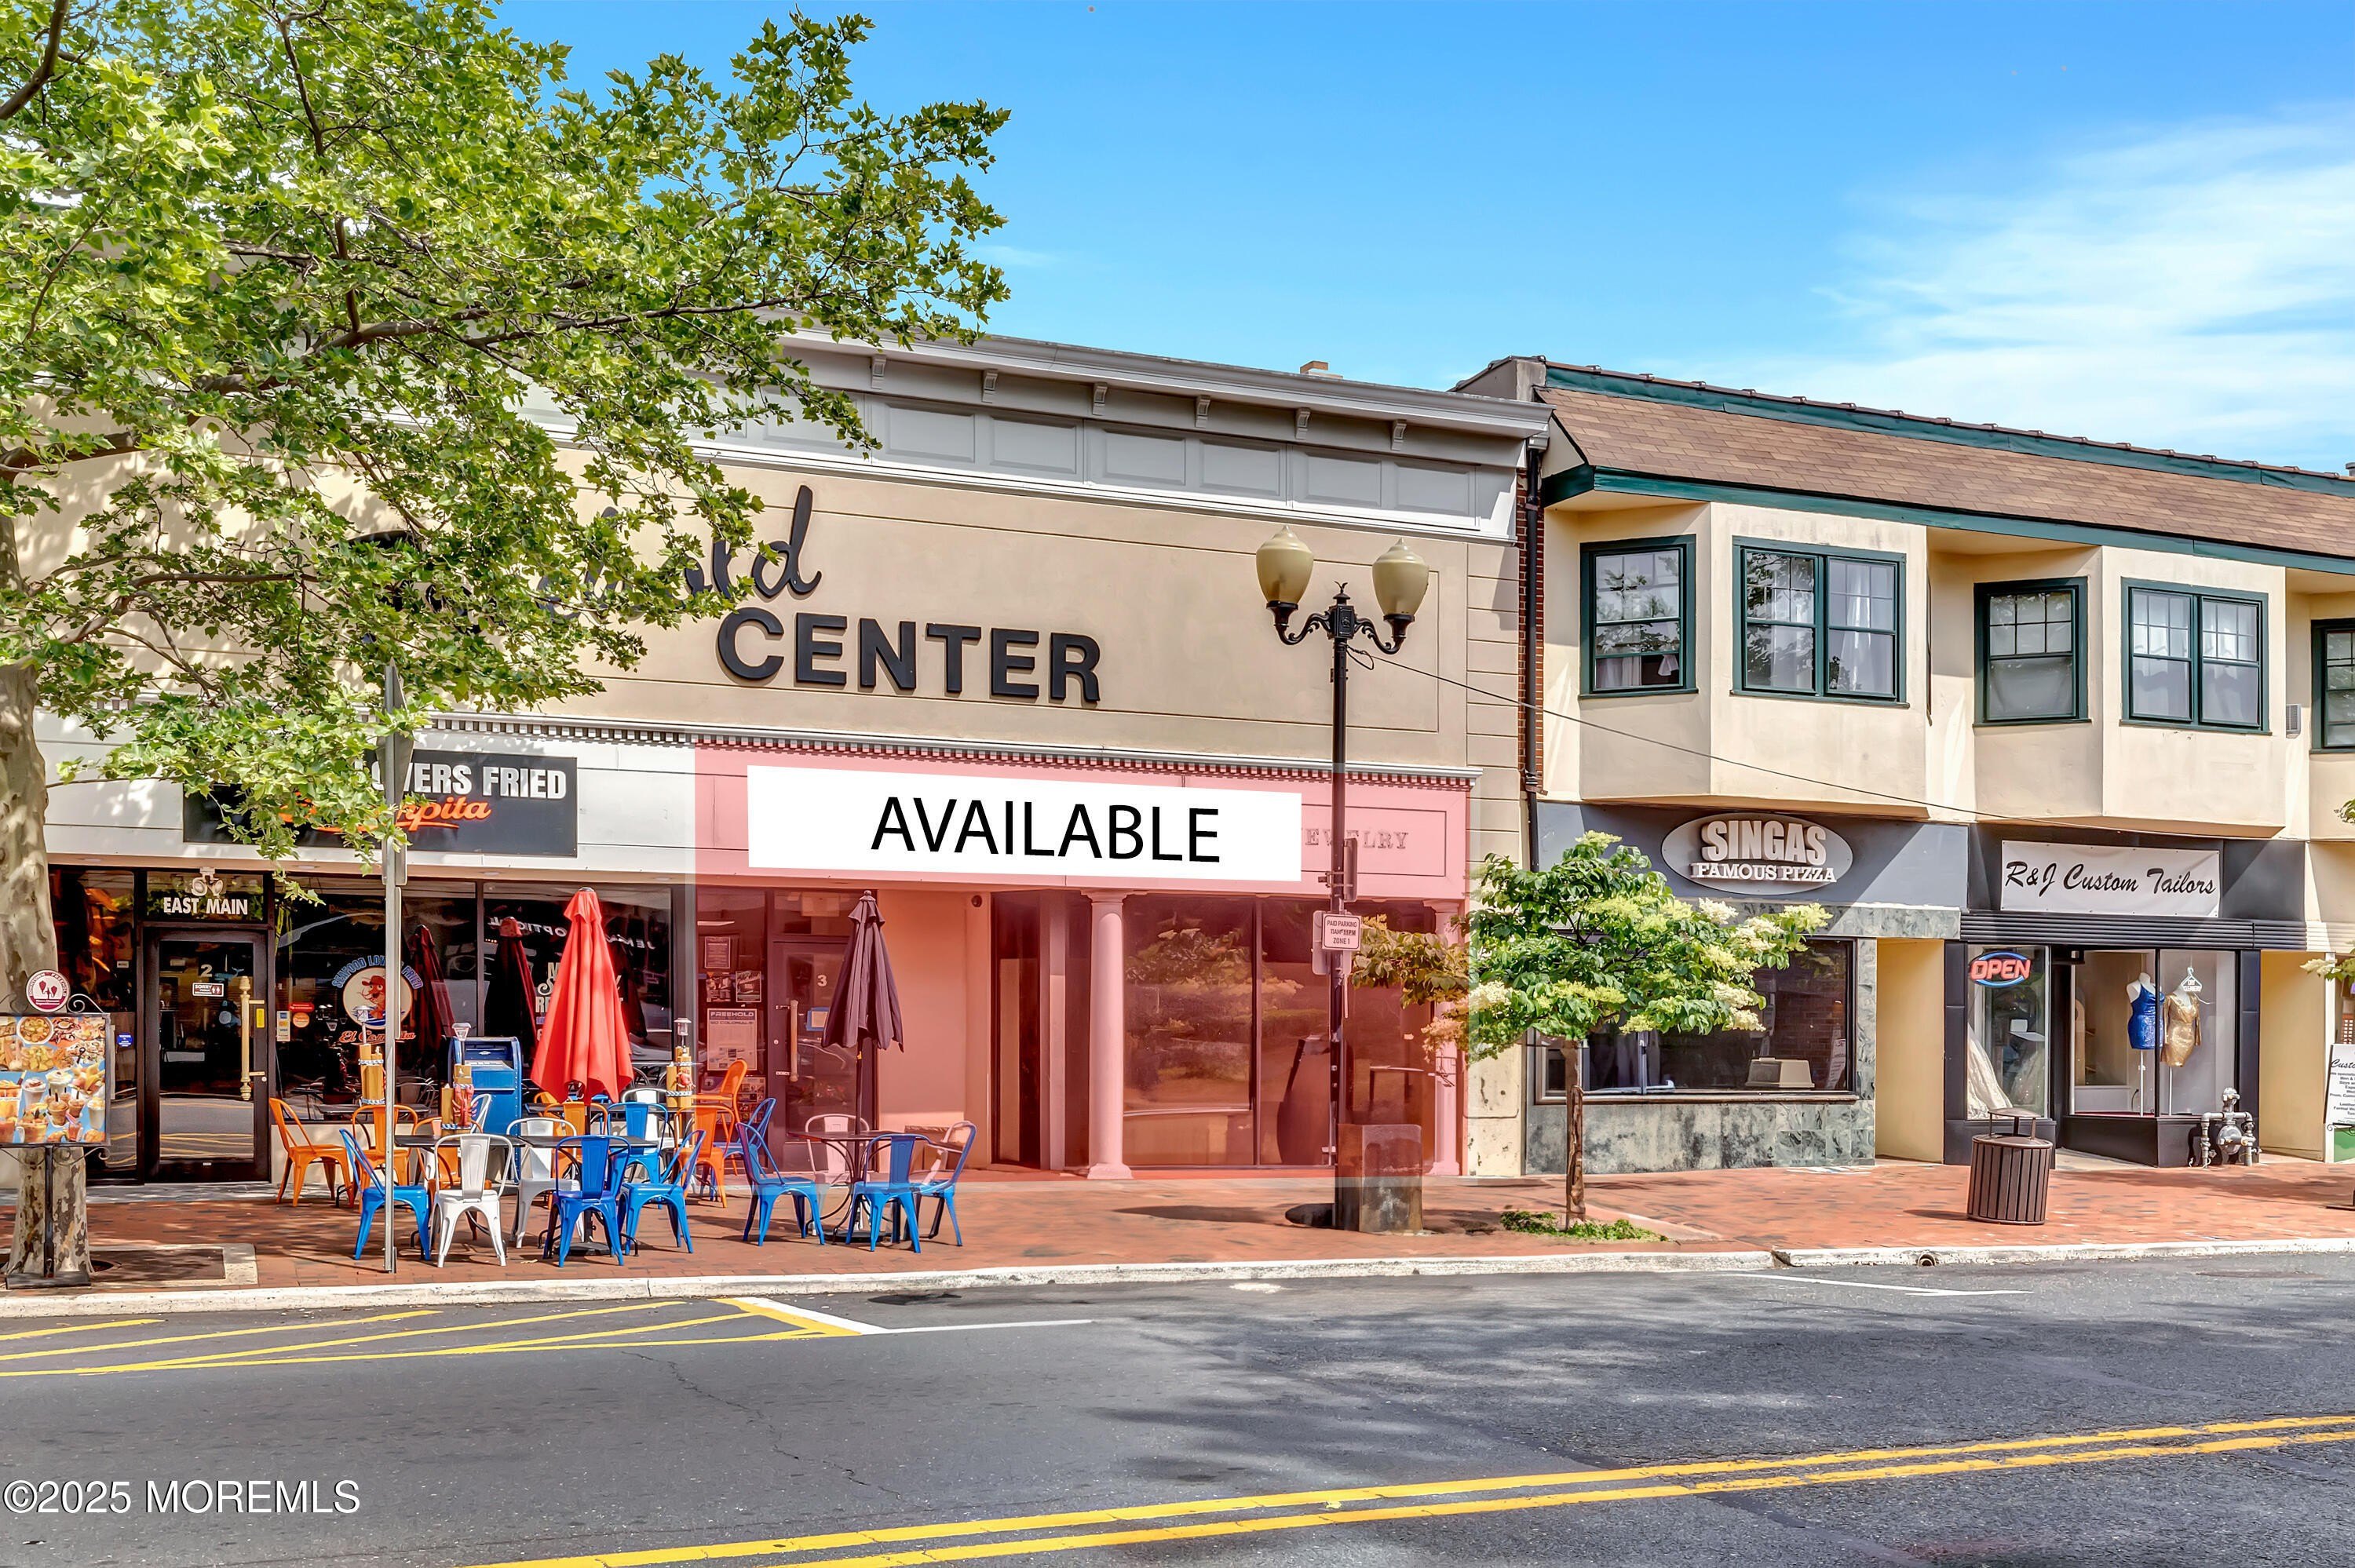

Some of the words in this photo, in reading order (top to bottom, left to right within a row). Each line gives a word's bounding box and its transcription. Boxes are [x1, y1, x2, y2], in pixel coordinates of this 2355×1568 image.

[717, 607, 1101, 702] CENTER
[356, 759, 472, 795] ERS
[484, 767, 567, 800] FRIED
[1302, 828, 1408, 849] ELRY
[1702, 820, 1827, 866] SINGAS
[1694, 862, 1778, 881] FAMOUS
[1780, 866, 1838, 883] PIZZA
[2005, 861, 2057, 896] R&J
[2063, 863, 2140, 892] Custom
[2146, 867, 2217, 895] Tailors
[163, 897, 199, 913] EAST
[206, 898, 248, 915] MAIN
[200, 964, 213, 978] 2
[331, 957, 367, 989] SEAFOOD
[401, 965, 424, 990] FRIED
[1970, 958, 2032, 980] OPEN
[817, 975, 827, 986] 3
